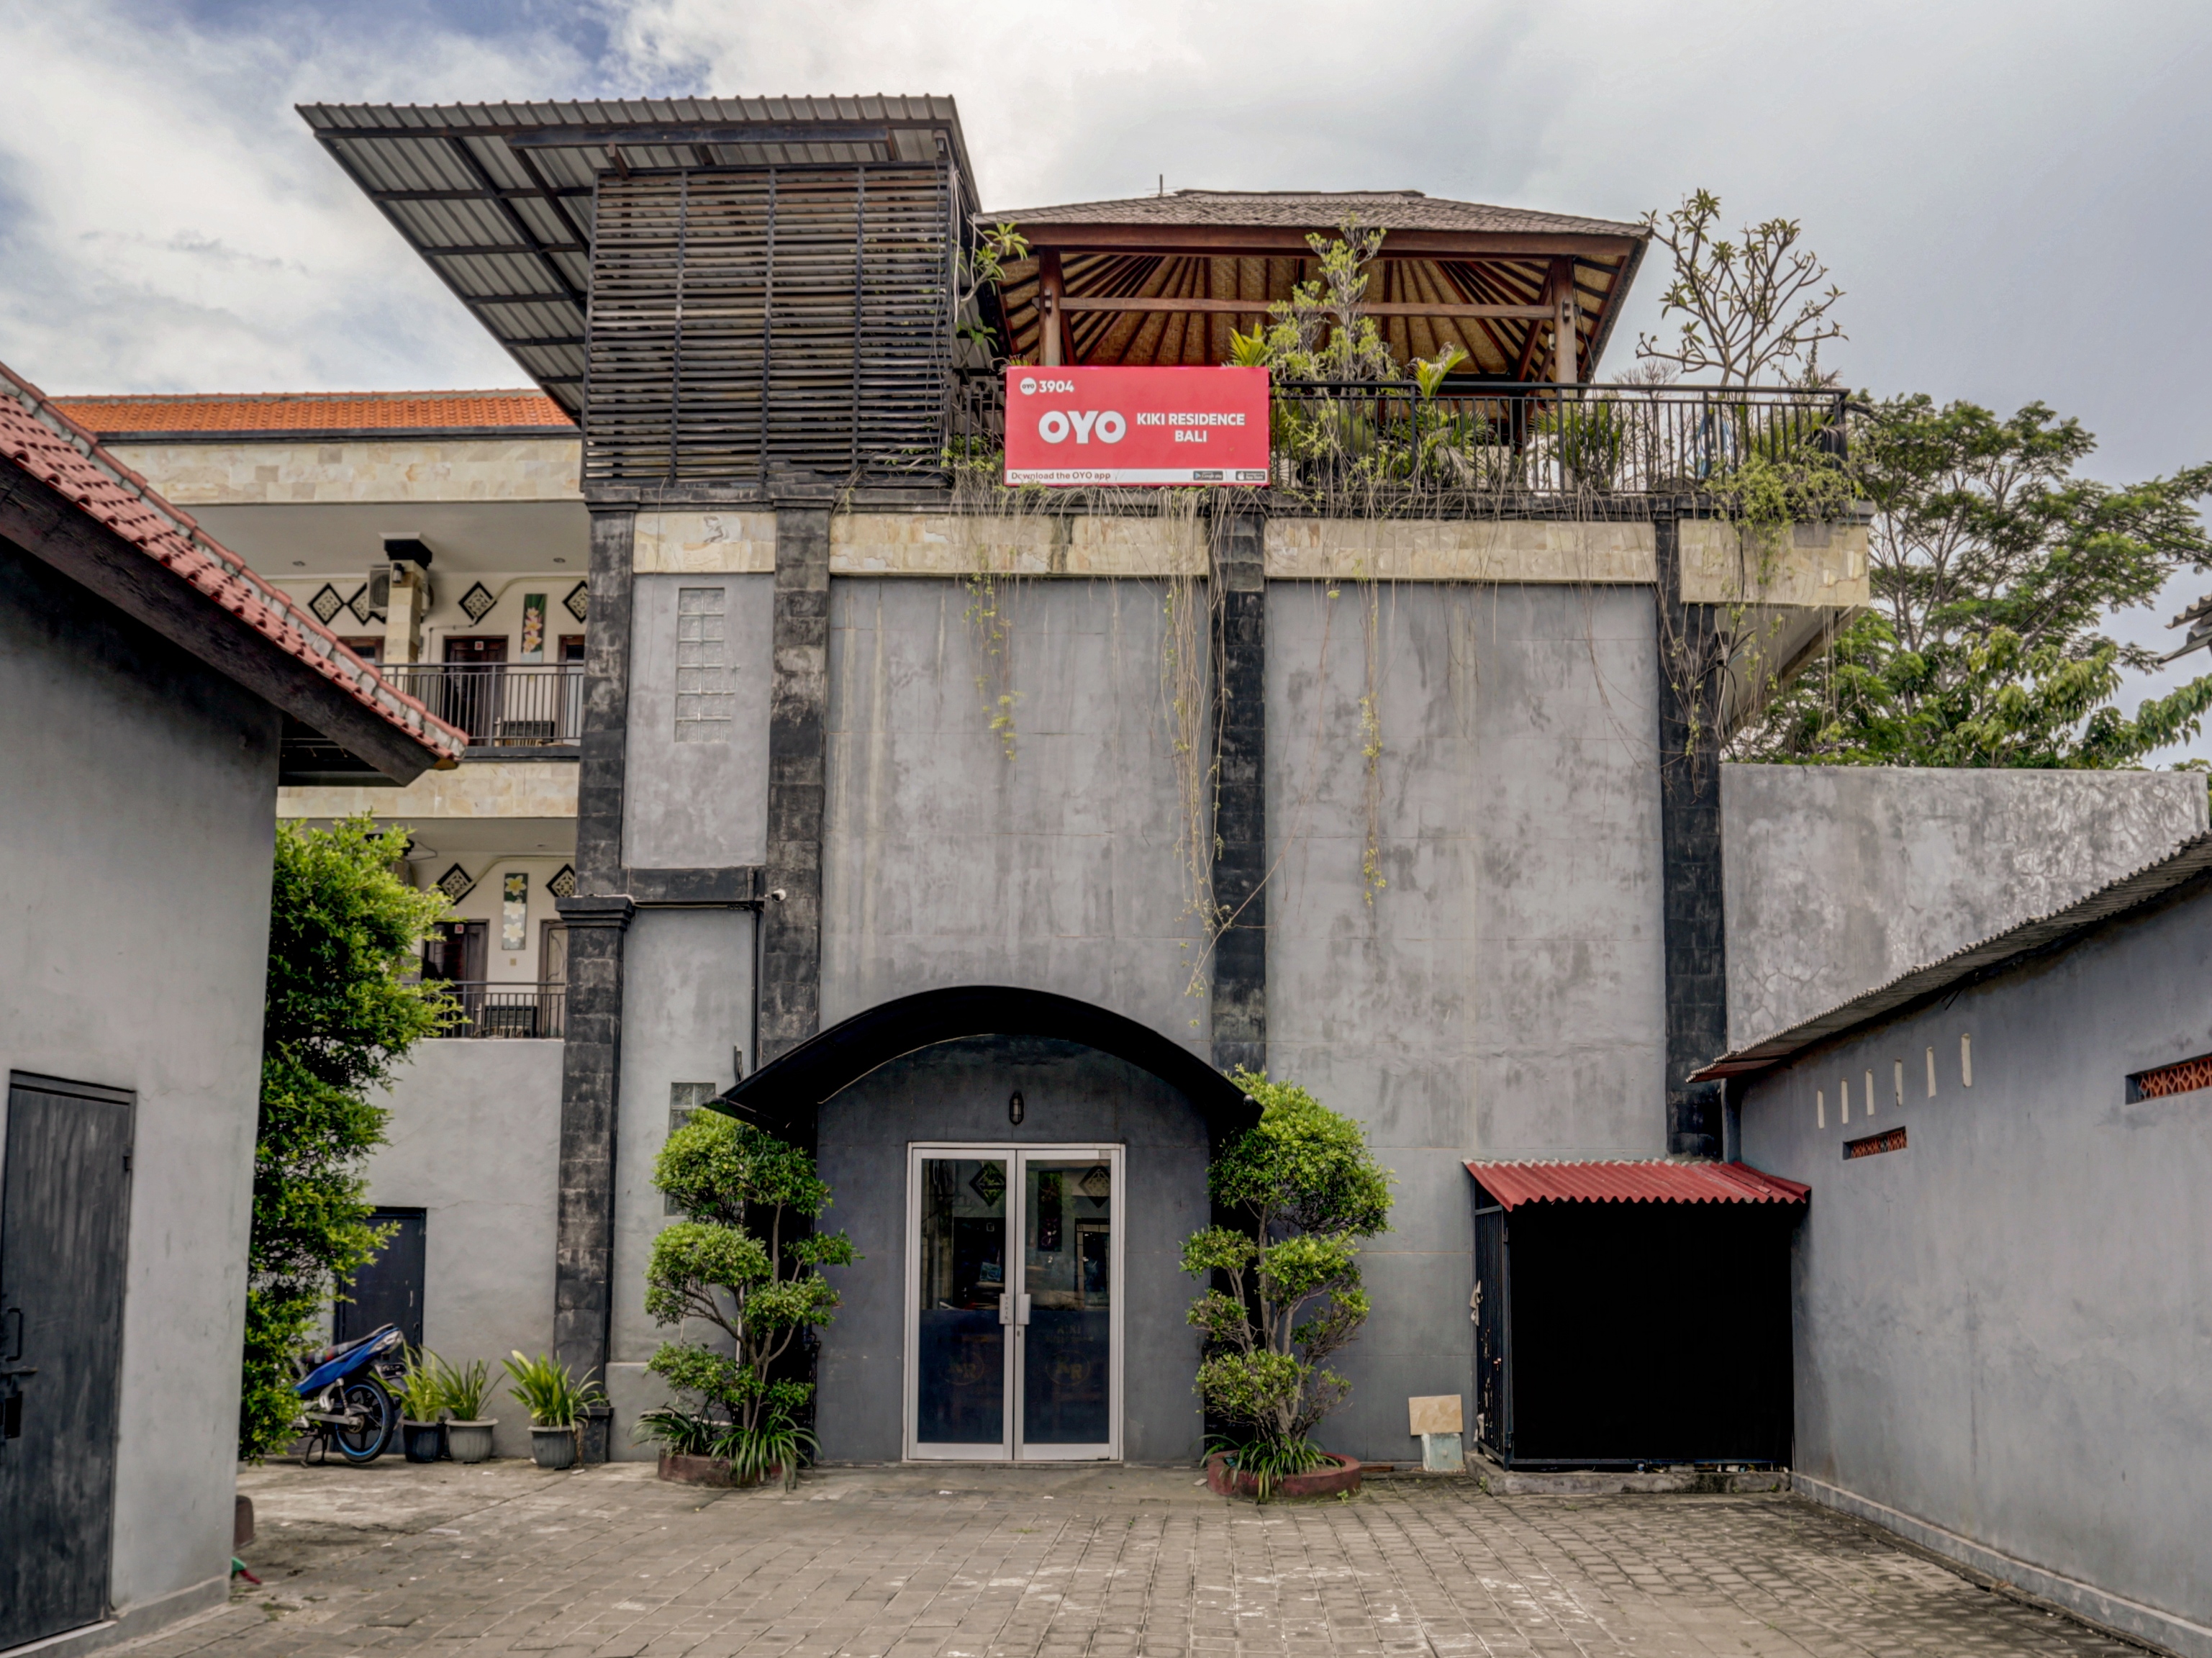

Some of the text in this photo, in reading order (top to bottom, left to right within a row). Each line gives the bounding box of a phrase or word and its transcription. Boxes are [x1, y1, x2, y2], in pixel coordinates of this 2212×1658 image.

[1039, 380, 1074, 393] 3904
[1137, 413, 1245, 425] KIKI RESIDENCE
[1038, 410, 1126, 444] OYO
[1175, 430, 1207, 442] BALI
[1094, 473, 1110, 481] app
